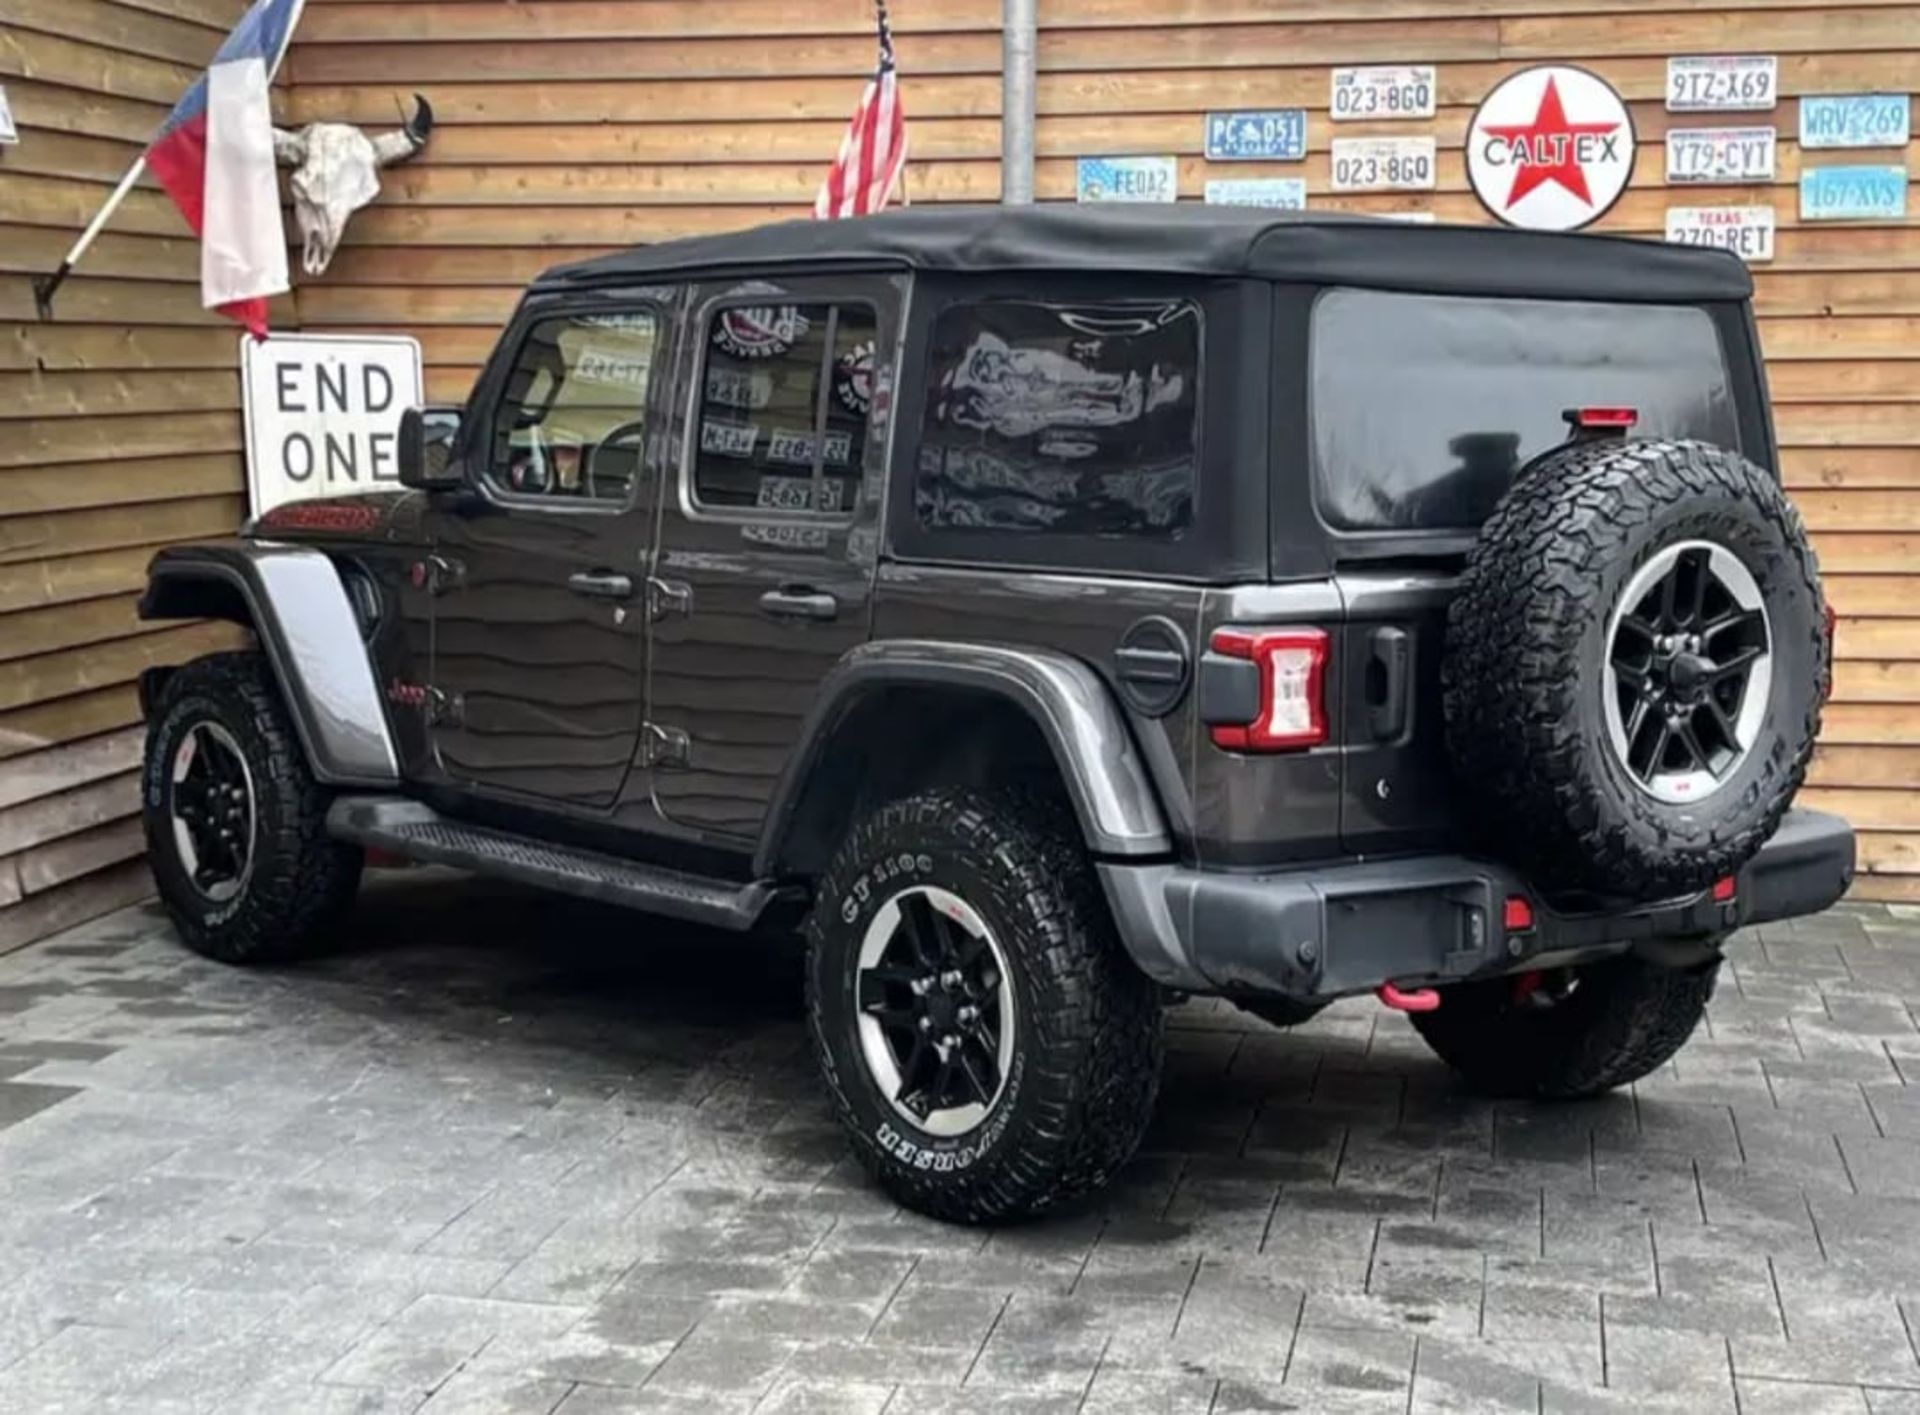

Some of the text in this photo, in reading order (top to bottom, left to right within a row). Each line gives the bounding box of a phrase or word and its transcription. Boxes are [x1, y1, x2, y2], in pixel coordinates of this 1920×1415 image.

[1864, 105, 1904, 135] 269
[1483, 133, 1619, 166] CALTEX
[1699, 211, 1741, 225] TEXAS
[276, 362, 393, 413] END
[282, 431, 399, 483] ONE
